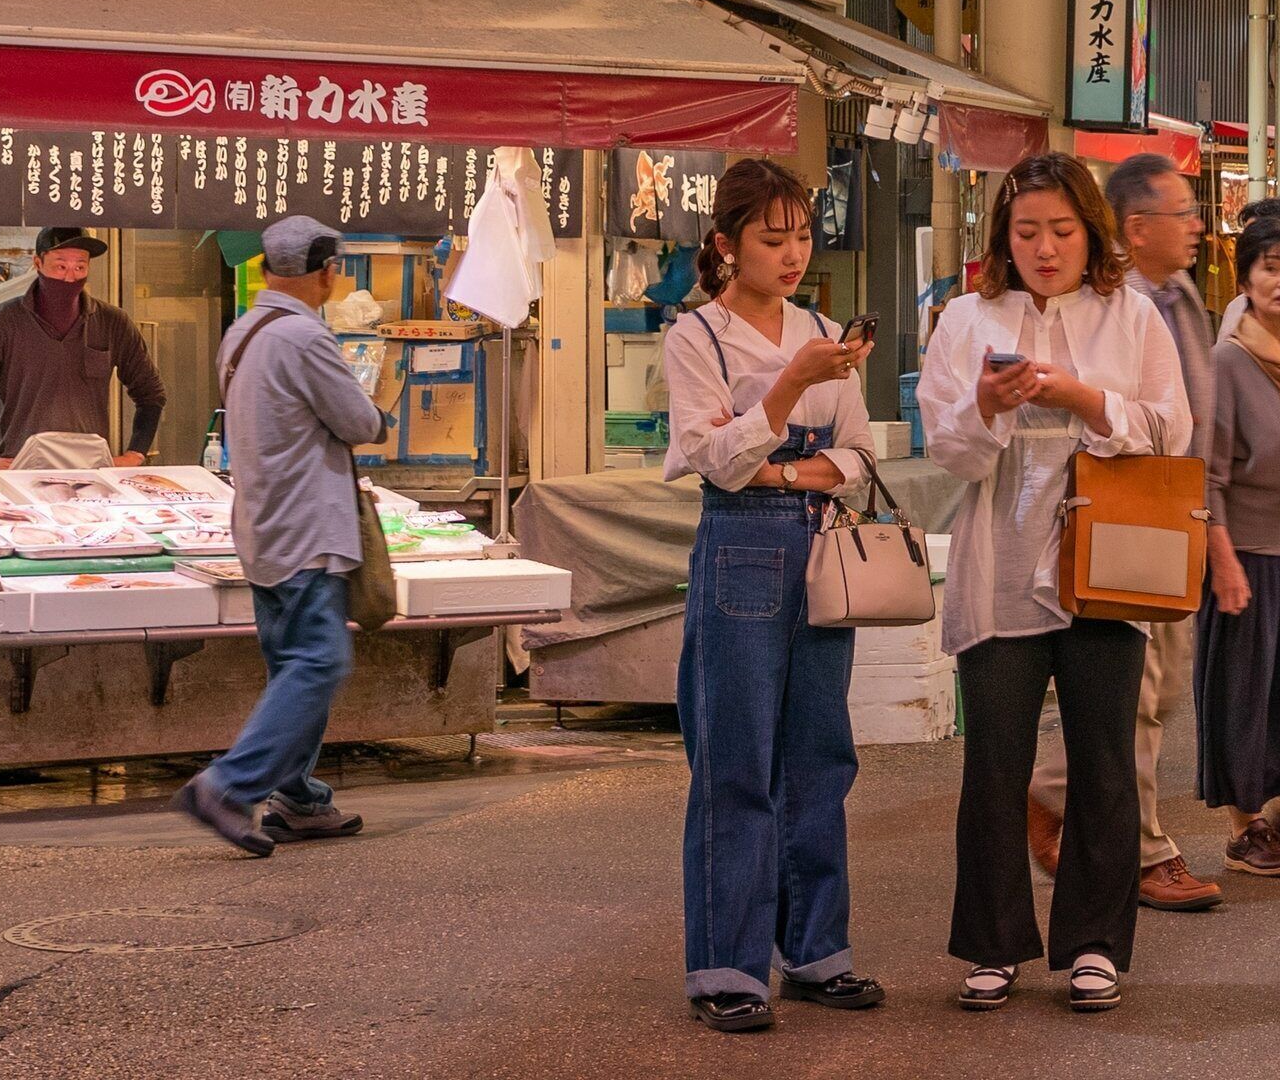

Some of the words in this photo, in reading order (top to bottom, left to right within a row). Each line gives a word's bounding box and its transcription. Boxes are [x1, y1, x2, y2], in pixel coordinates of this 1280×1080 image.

[48, 145, 62, 203] まぐろ
[195, 140, 207, 190] ほっけ
[256, 148, 268, 220] やりいか
[275, 138, 289, 214] おりいか
[417, 144, 430, 201] 白えび
[340, 167, 354, 224] 甘えび
